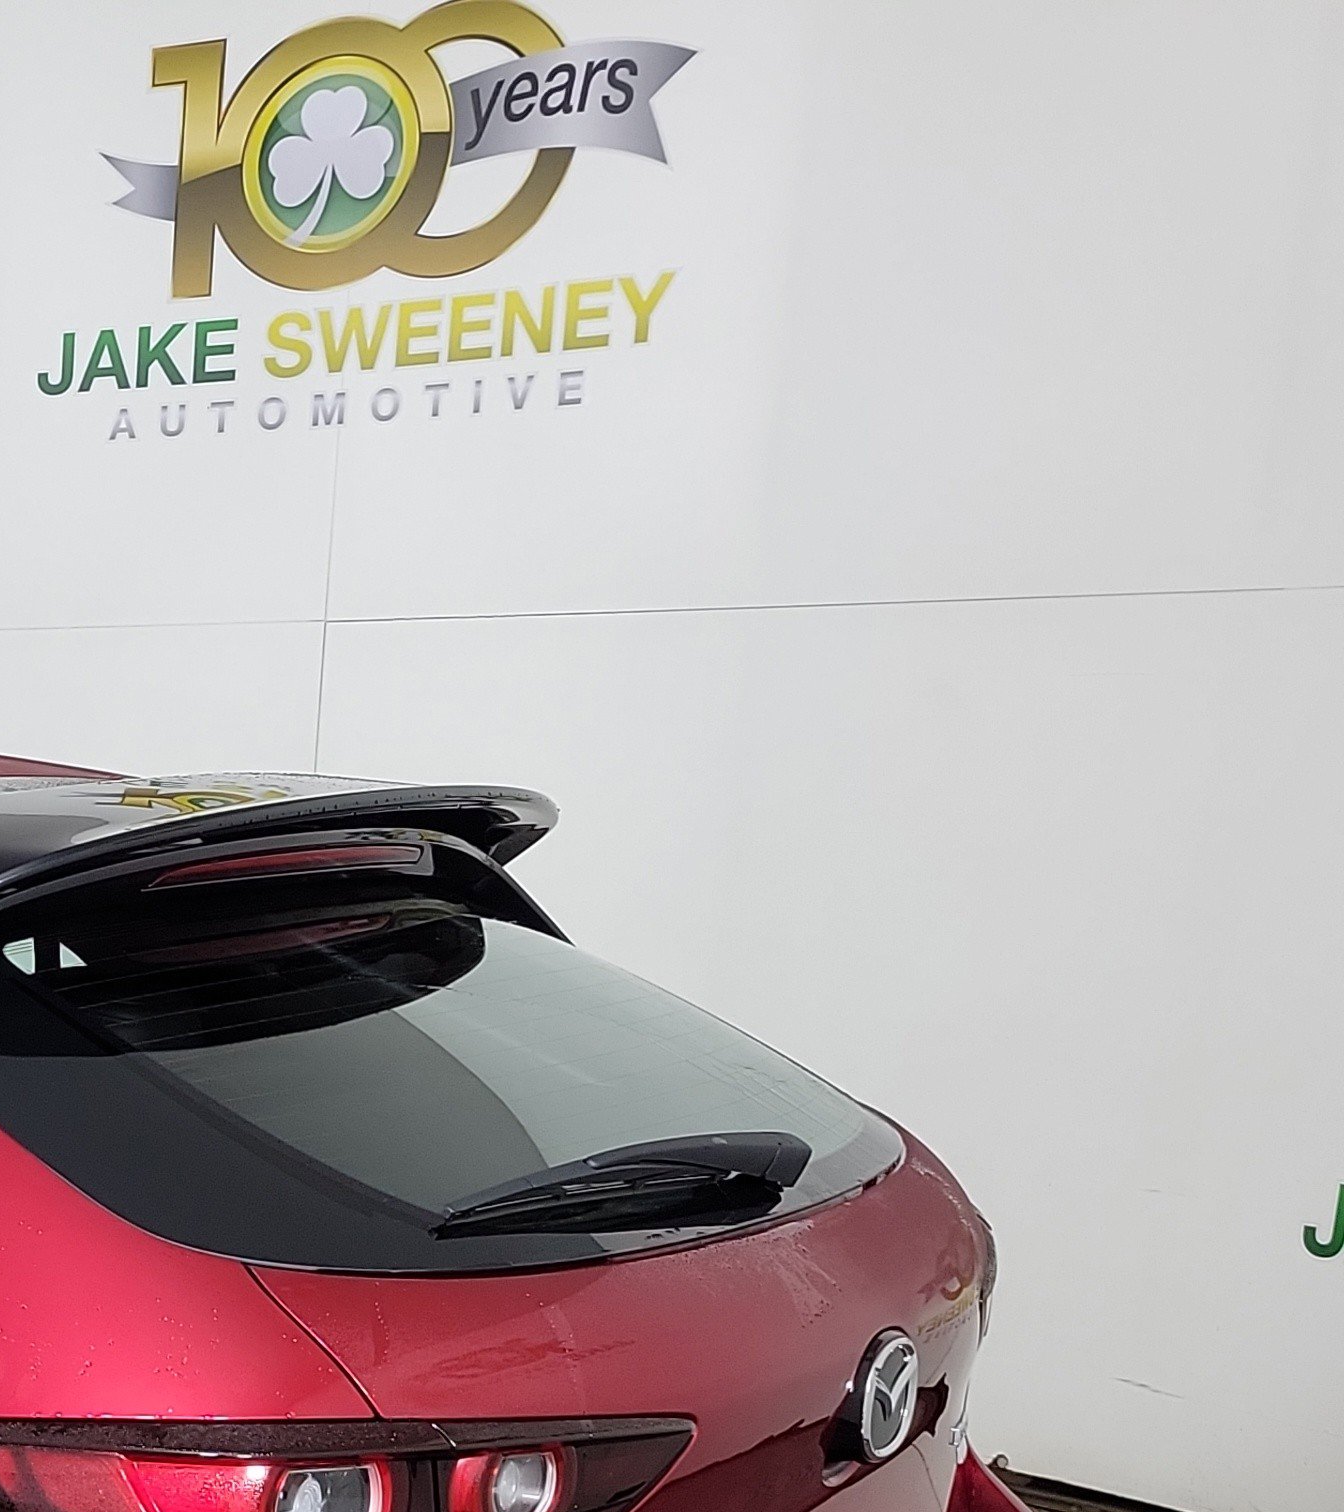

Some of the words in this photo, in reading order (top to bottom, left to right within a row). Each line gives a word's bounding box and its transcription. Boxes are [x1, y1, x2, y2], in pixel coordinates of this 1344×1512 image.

[464, 57, 639, 152] years
[36, 318, 240, 396] JAKE
[263, 270, 678, 380] SWEENEY
[108, 370, 586, 441] AUTOMOTIVE
